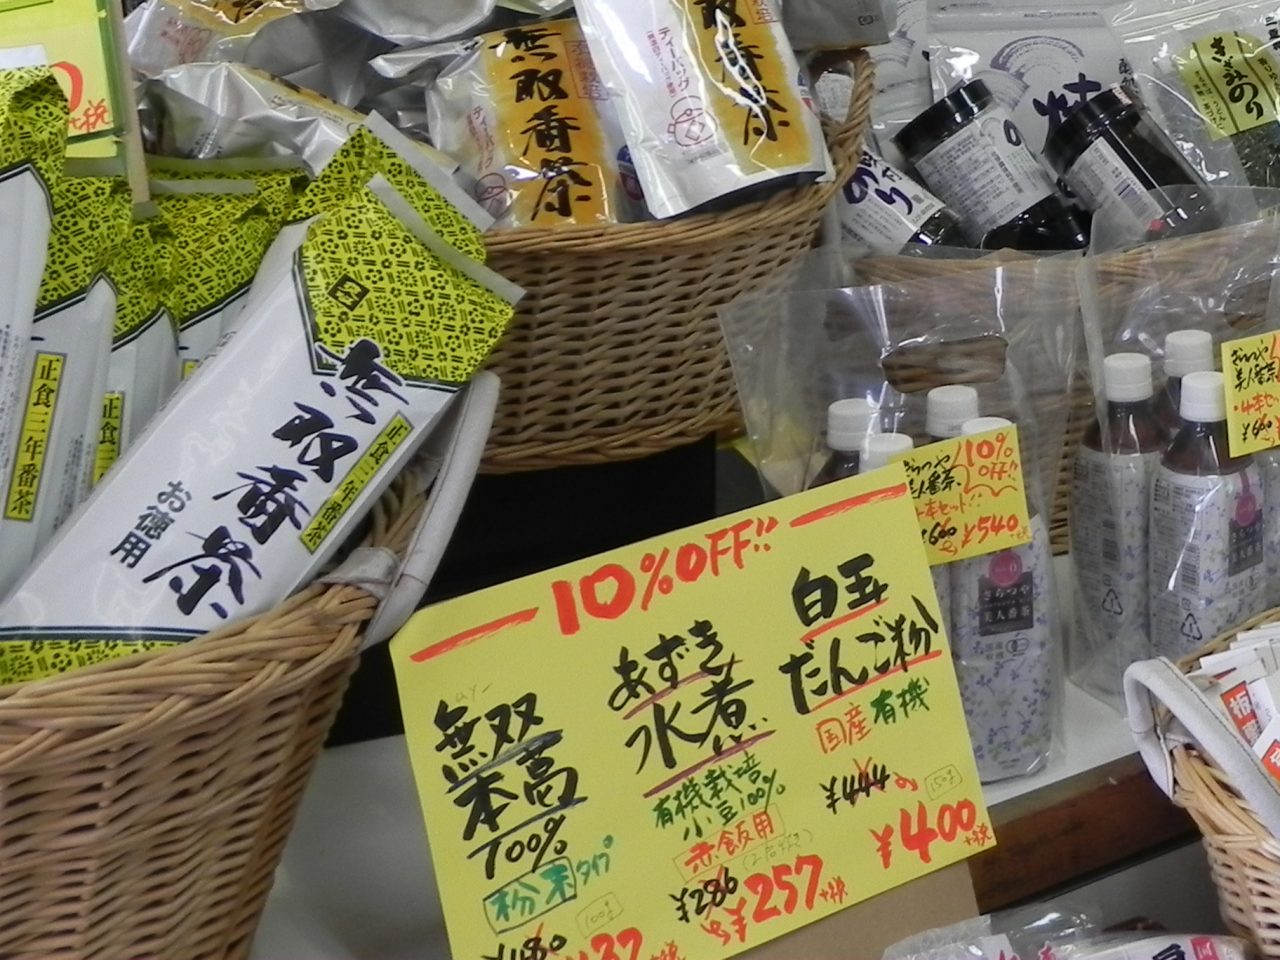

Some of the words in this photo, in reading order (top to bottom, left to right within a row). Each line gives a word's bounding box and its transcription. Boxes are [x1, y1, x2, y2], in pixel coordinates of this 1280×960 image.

[10, 356, 61, 517] 正食三年番茶
[965, 430, 1015, 468] 10%
[110, 479, 193, 571] お徳用
[960, 513, 1019, 549] ¥540
[551, 516, 779, 636] 10%OFF!!
[790, 551, 890, 627] 白玉
[606, 619, 736, 712] あずき
[779, 594, 940, 716] だんご粉
[651, 749, 762, 829] 有機栽培
[870, 797, 977, 871] ¥400
[721, 853, 824, 943] ¥257
